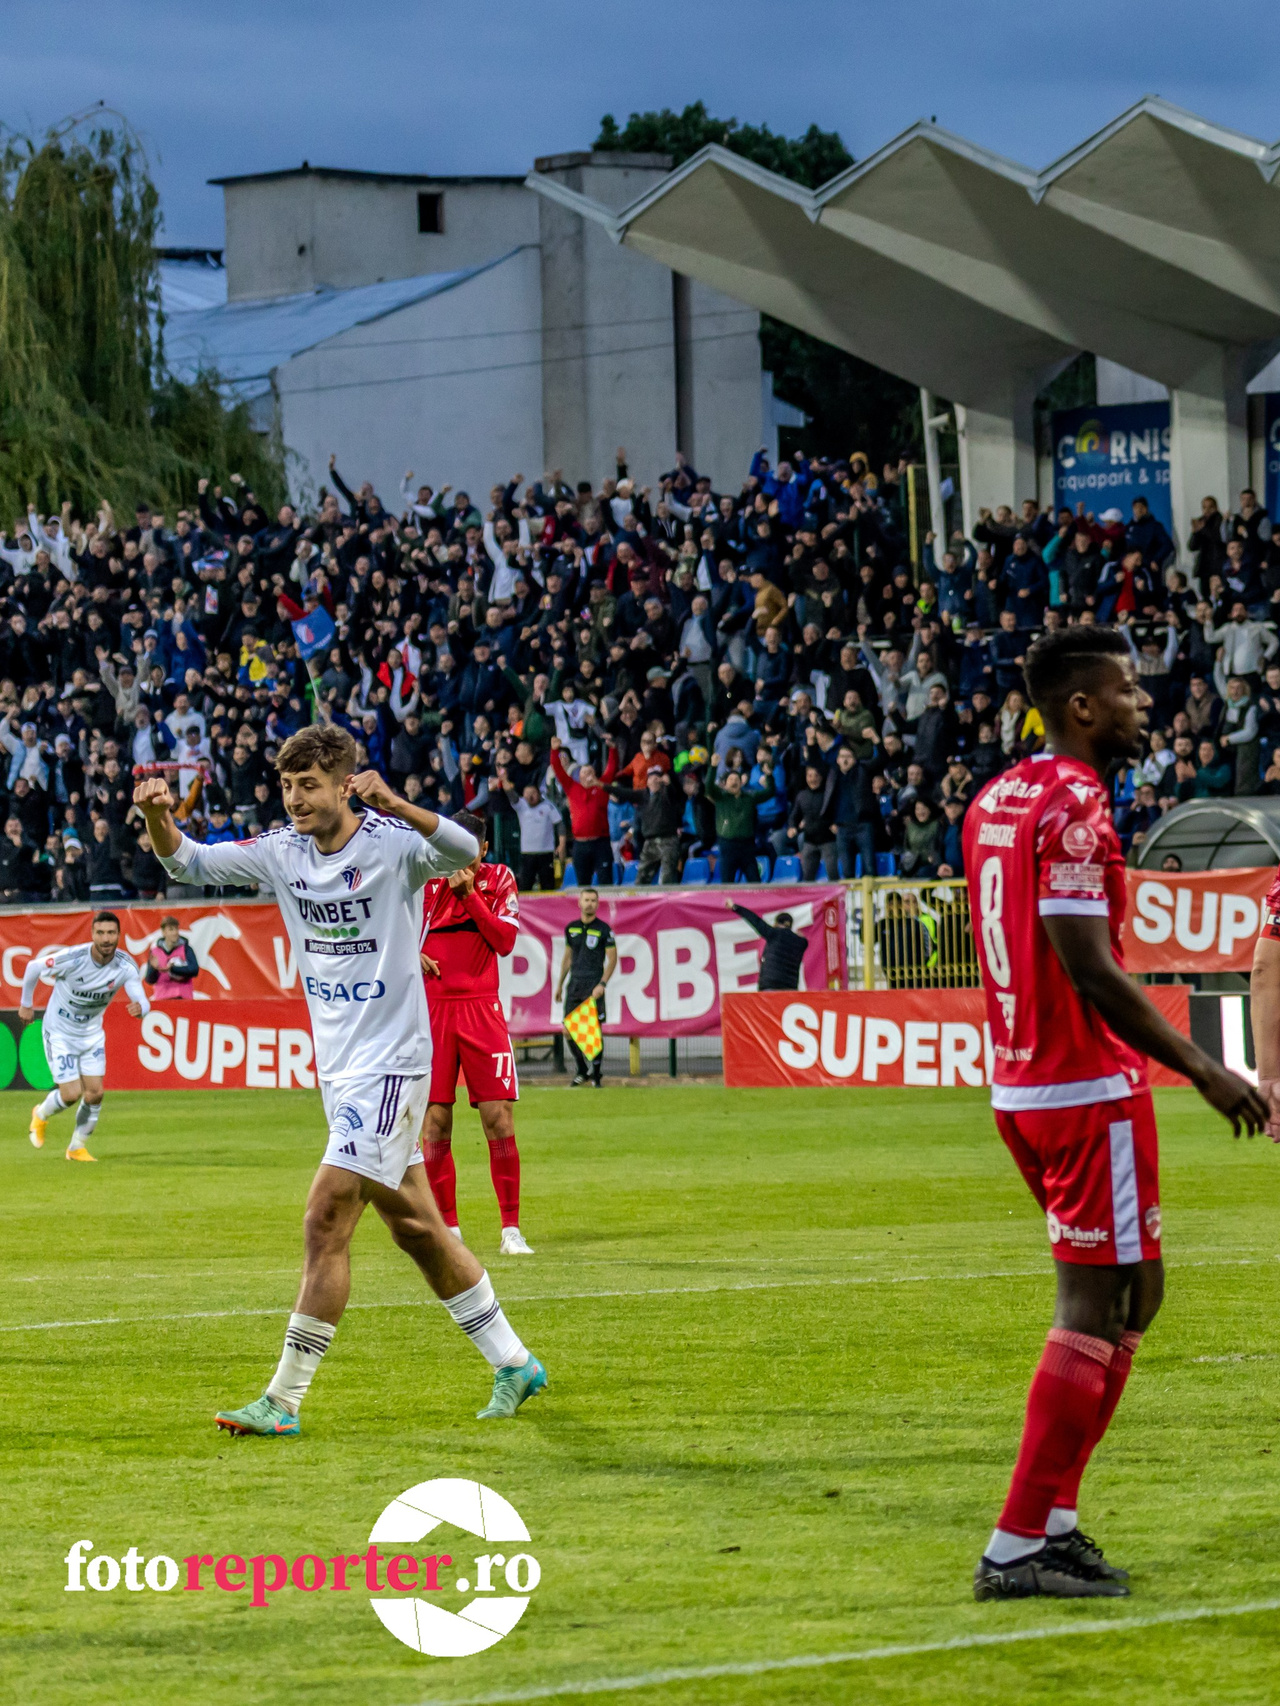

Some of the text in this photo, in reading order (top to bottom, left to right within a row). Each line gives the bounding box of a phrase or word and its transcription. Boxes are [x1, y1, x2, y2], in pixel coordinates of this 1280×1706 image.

[1058, 468, 1133, 493] aquapark
[1138, 467, 1149, 484] &
[299, 896, 372, 923] UNIBET
[979, 856, 1012, 989] 8
[336, 944, 357, 954] SPRE
[357, 942, 373, 953] 0%
[57, 1054, 75, 1071] 30
[491, 1052, 512, 1078] 77
[1060, 1224, 1109, 1242] Tehnic
